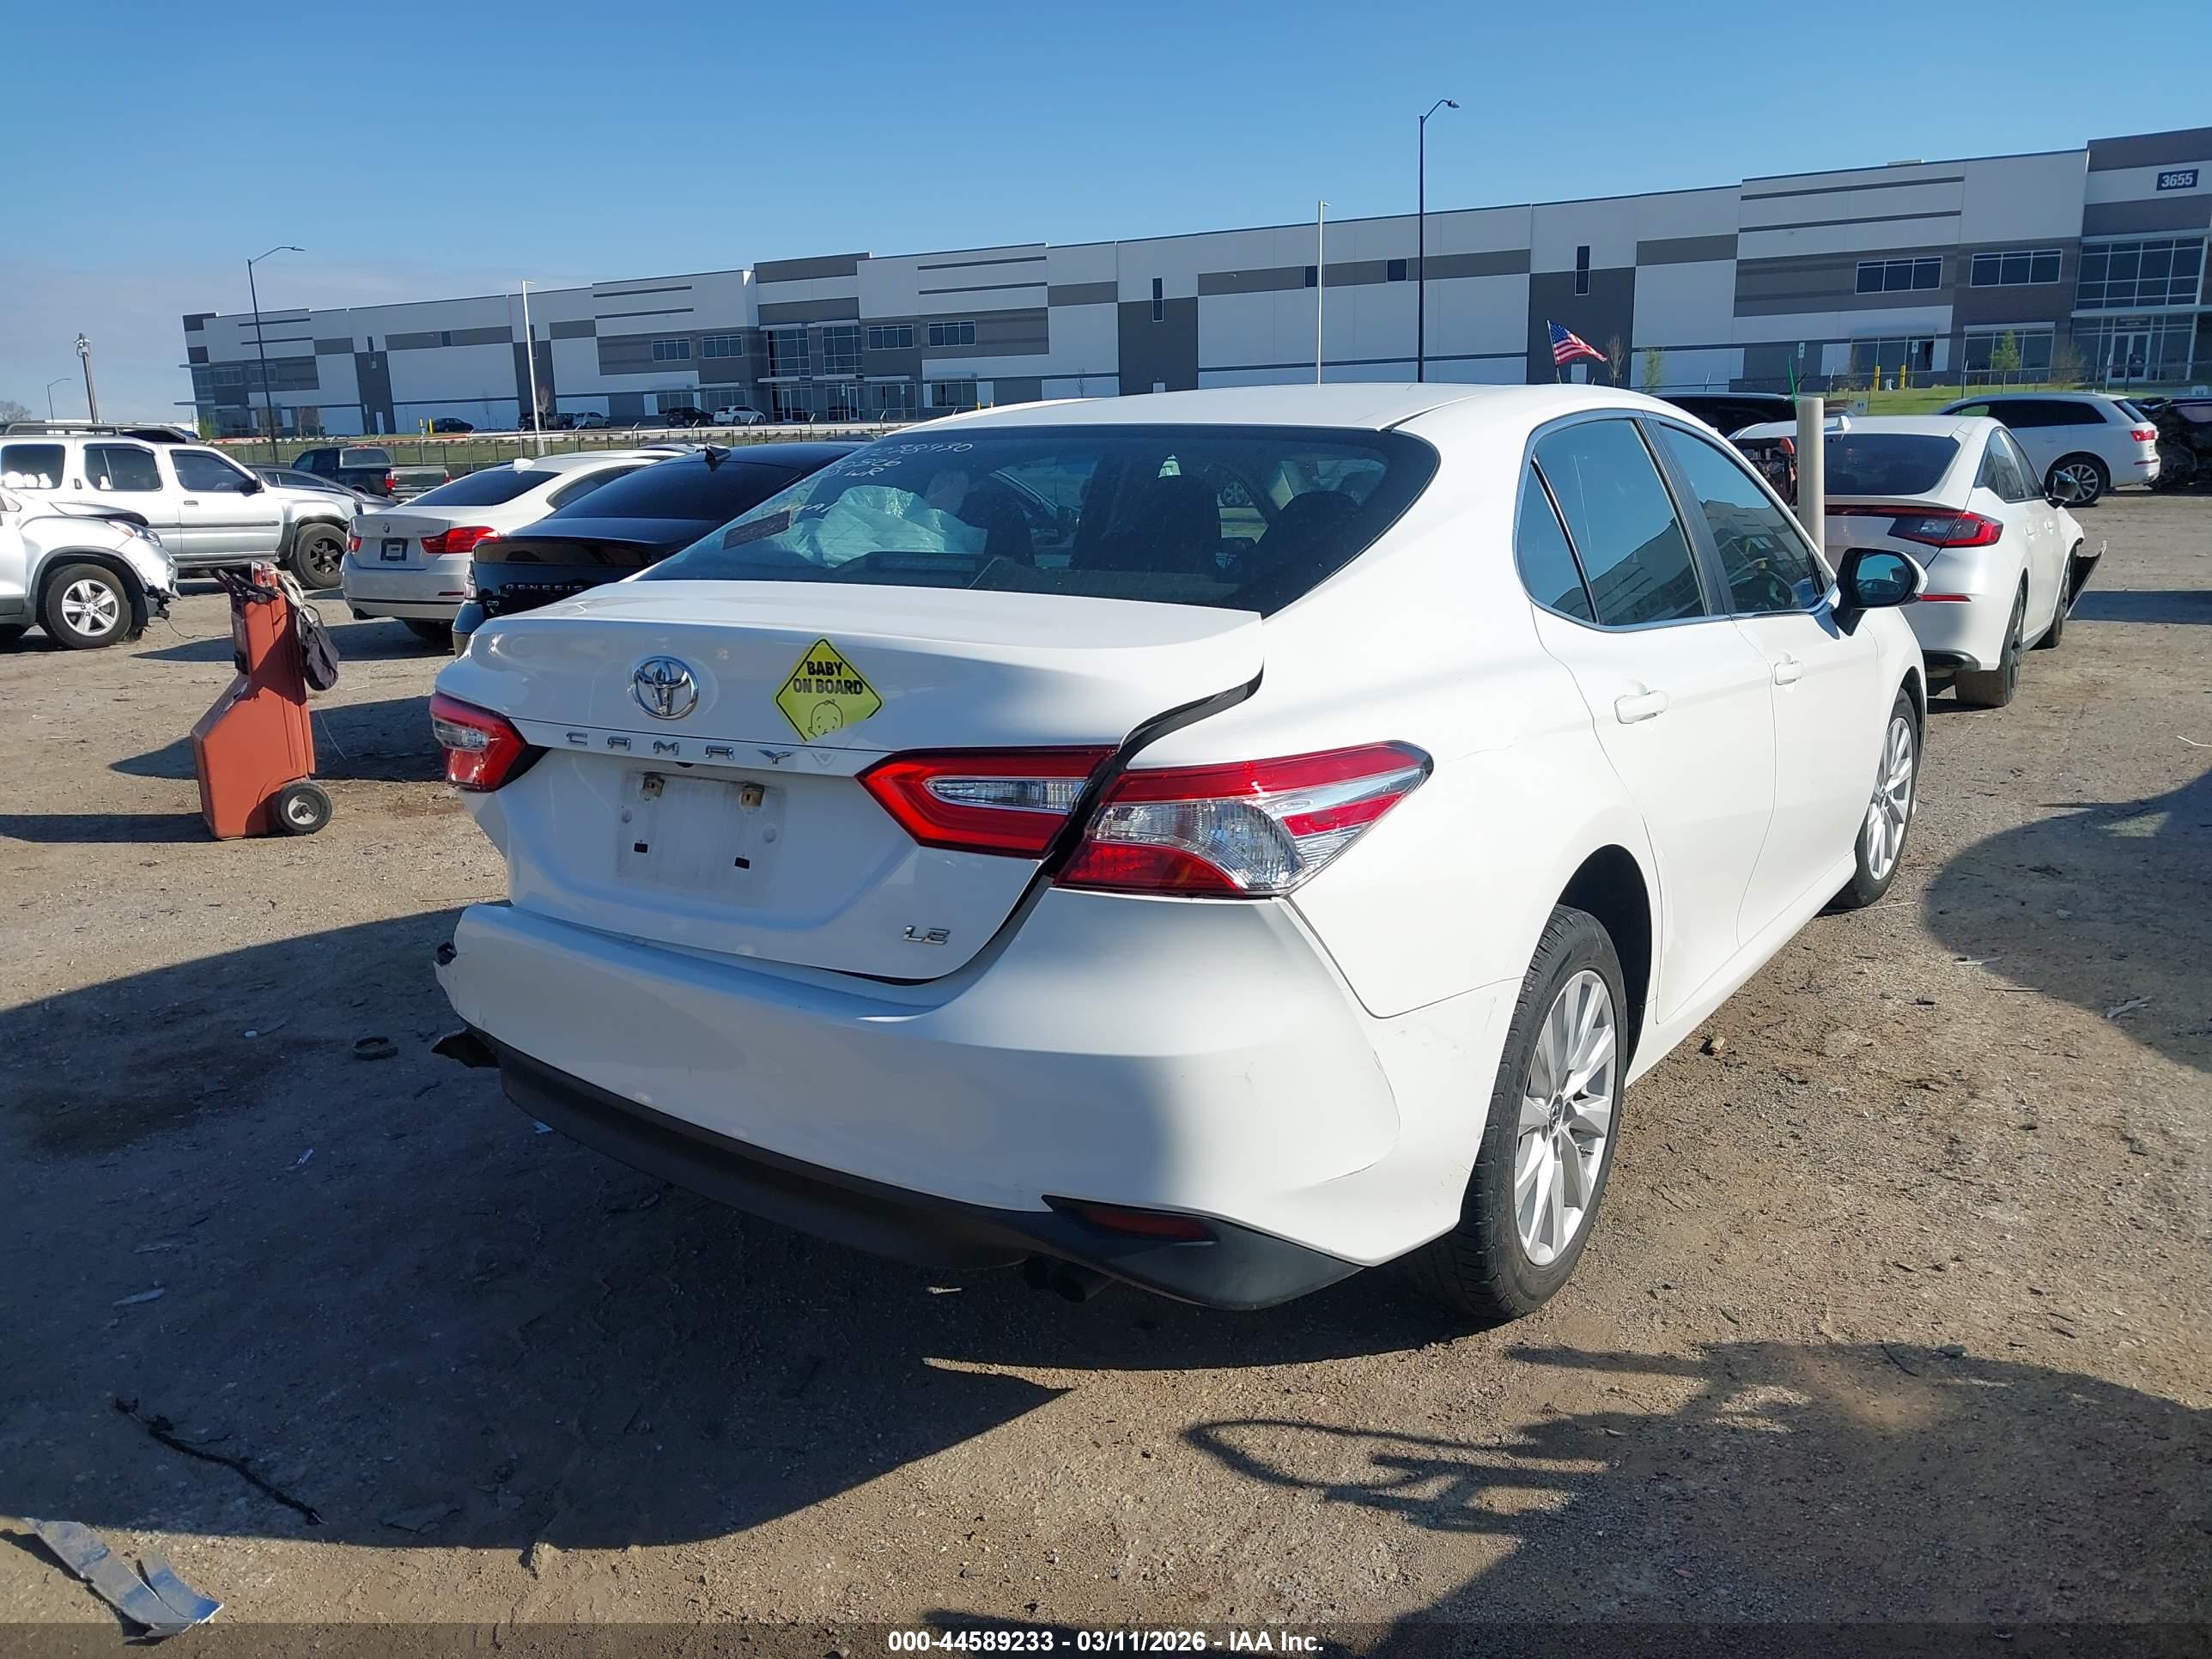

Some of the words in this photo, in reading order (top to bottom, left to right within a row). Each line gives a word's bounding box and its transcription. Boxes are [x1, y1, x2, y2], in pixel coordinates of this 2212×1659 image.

[2161, 173, 2193, 187] 3655
[806, 660, 843, 677] BABY
[793, 678, 812, 694] ON
[816, 678, 864, 696] BOARD
[565, 731, 795, 765] CAMRY
[902, 925, 951, 945] LE
